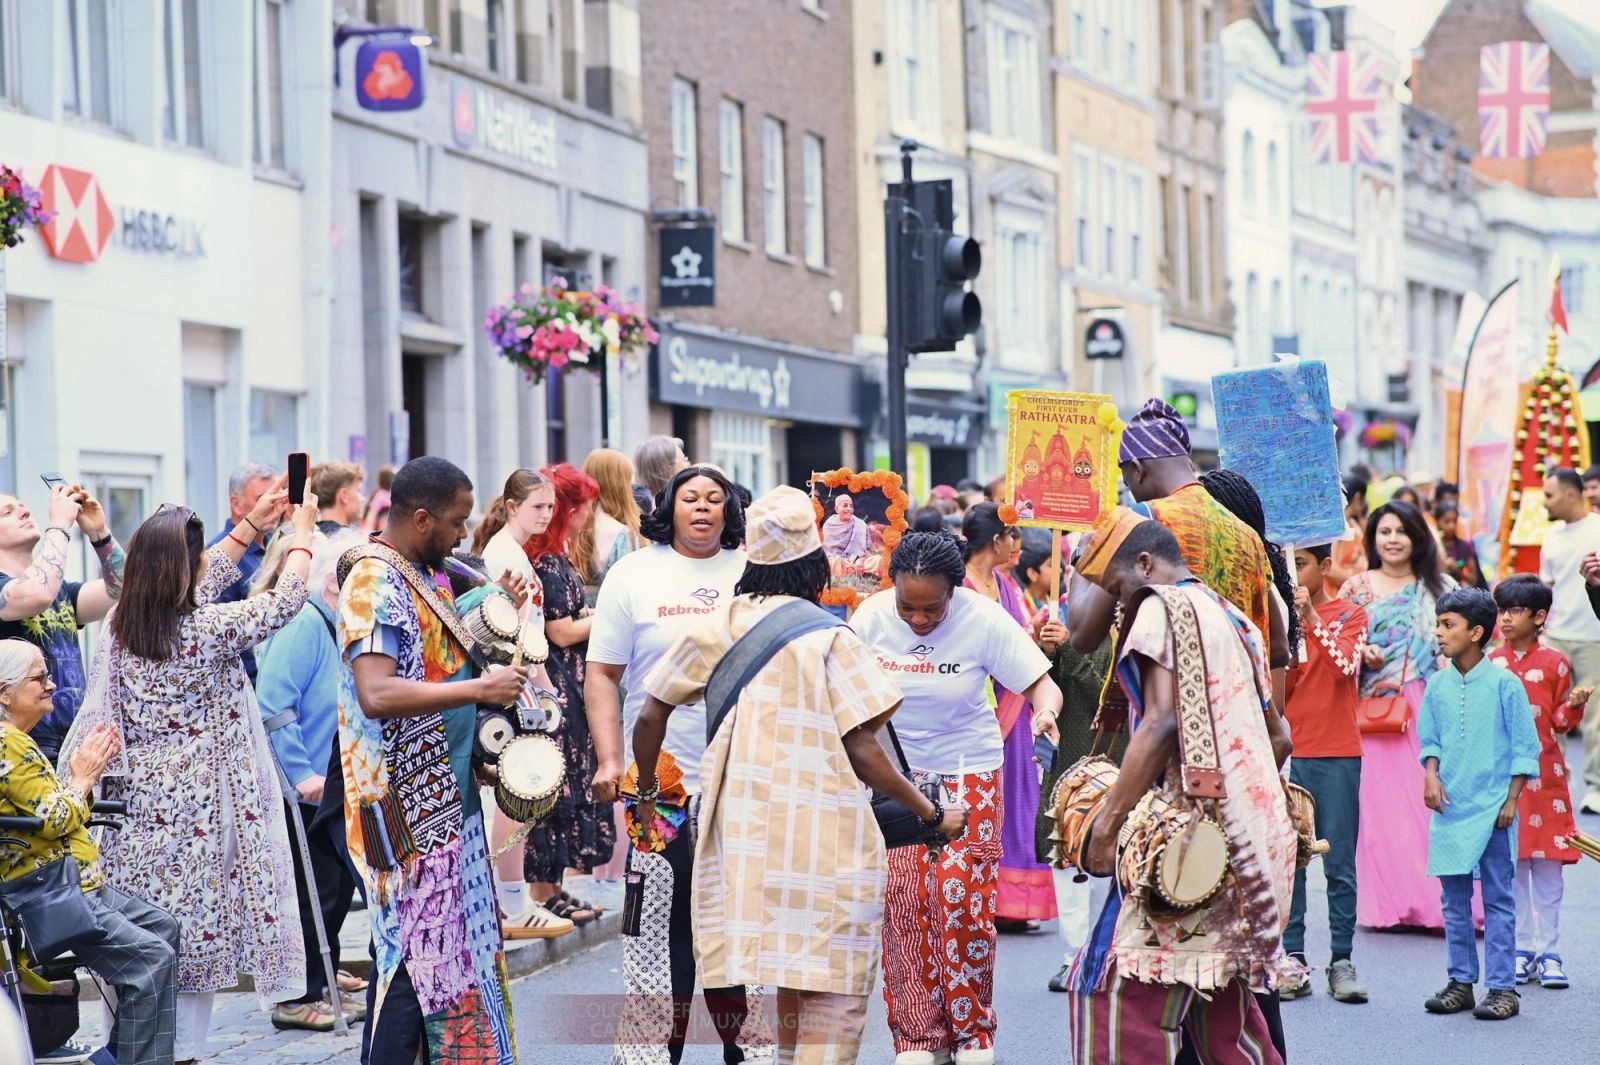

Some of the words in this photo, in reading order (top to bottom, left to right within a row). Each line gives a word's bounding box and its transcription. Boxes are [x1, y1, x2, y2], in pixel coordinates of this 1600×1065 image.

[478, 90, 557, 167] NatWest
[669, 336, 773, 408] Superdrug
[1027, 397, 1085, 407] CHELMSFORD'S
[1020, 411, 1097, 425] RATHAYATRA
[657, 604, 721, 618] Rebrea
[938, 663, 961, 674] CIC
